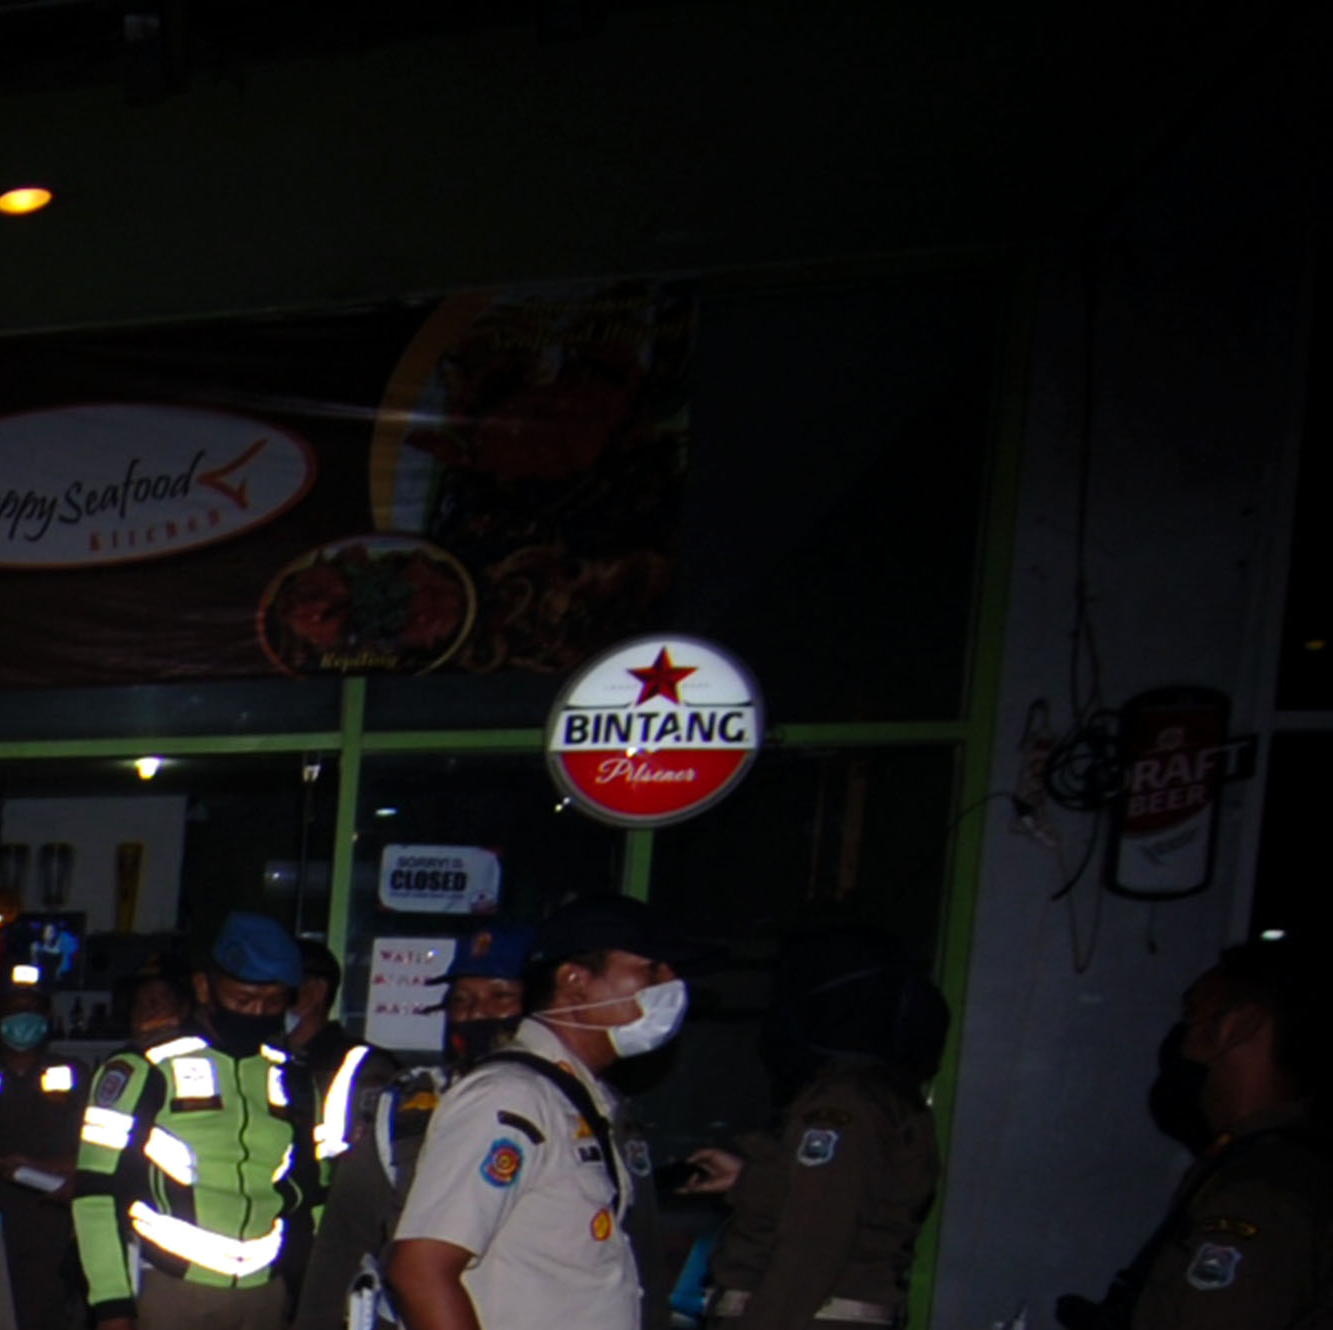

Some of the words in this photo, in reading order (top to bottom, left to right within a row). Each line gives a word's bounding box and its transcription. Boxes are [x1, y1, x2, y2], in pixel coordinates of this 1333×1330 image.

[58, 450, 206, 525] Seafood
[563, 711, 746, 745] BINTANG
[1128, 783, 1209, 818] BEER
[390, 869, 466, 891] CLOSED
